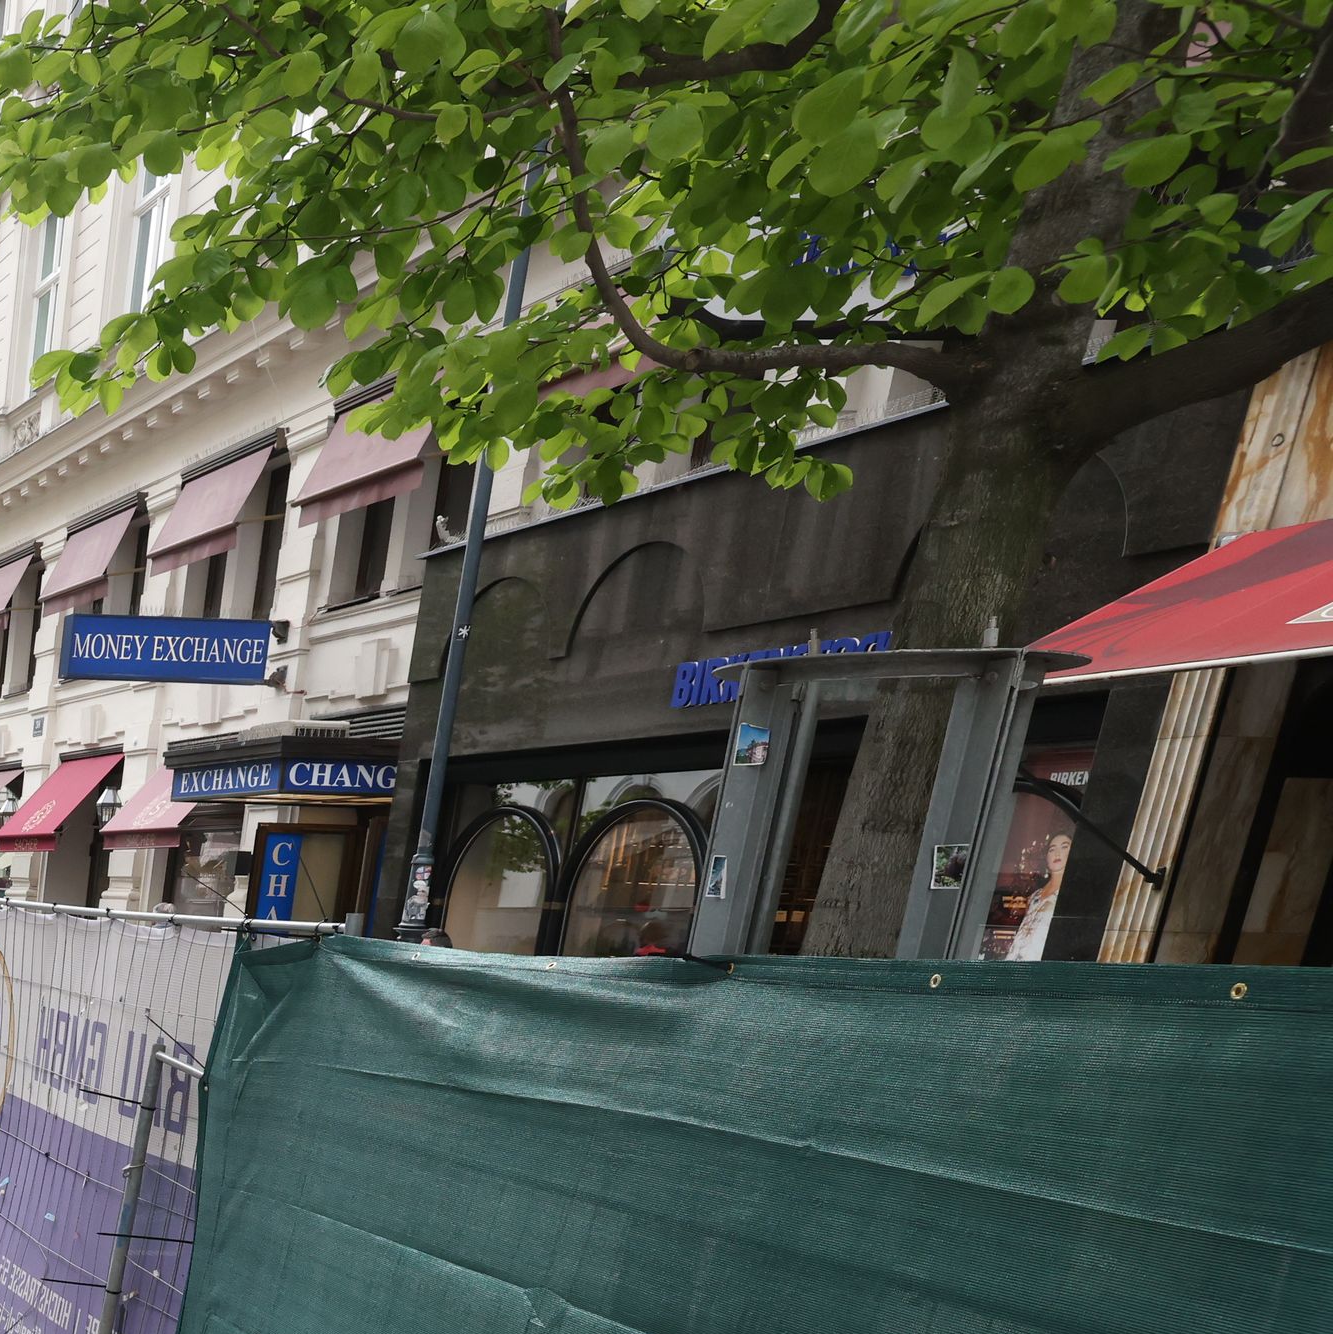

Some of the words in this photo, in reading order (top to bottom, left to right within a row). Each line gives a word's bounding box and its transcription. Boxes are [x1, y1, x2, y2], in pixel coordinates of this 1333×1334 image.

[72, 632, 148, 661] MONEY
[151, 635, 265, 665] EXCHANGE
[180, 763, 273, 794] EXCHANGE
